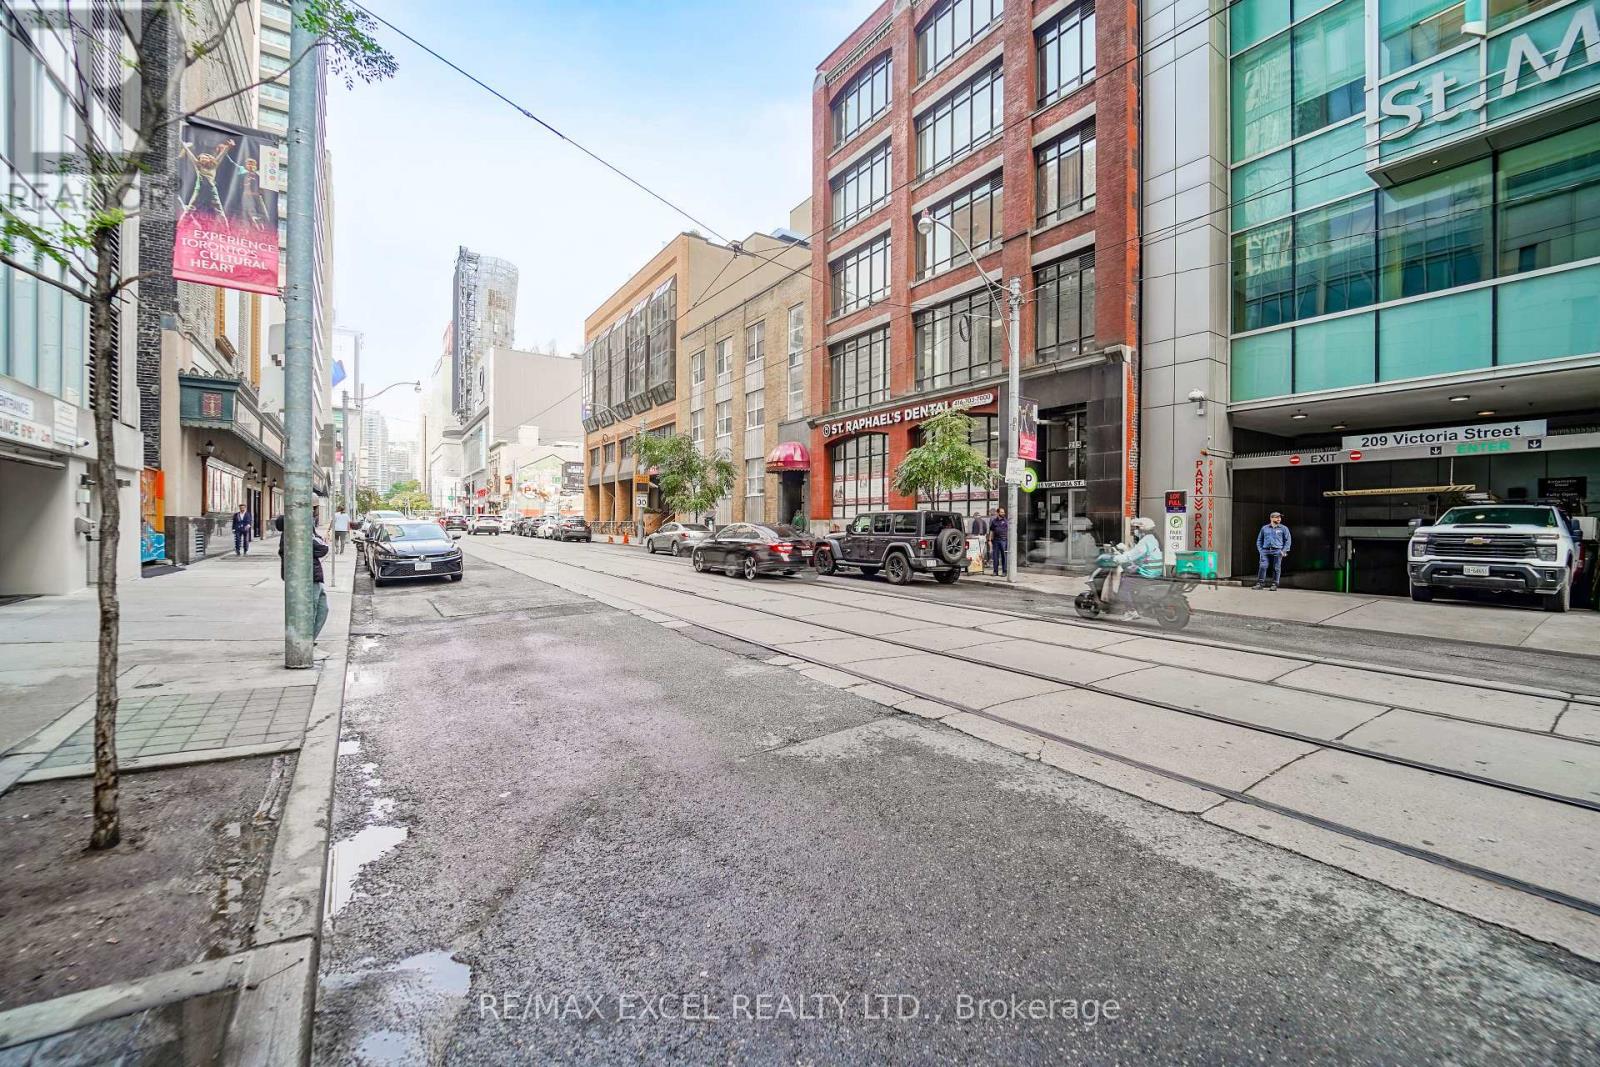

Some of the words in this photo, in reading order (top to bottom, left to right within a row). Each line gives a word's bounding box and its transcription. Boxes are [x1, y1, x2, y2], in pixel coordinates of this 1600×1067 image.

[1380, 71, 1485, 141] St.
[182, 237, 259, 259] TORONTO'S
[193, 229, 276, 253] EXPERIENCE
[189, 257, 236, 274] HEART
[200, 249, 269, 271] CULTURAL
[831, 423, 845, 435] ST.
[845, 409, 901, 433] RAPHAEL'S
[1361, 435, 1387, 448] 209
[1393, 430, 1459, 446] Victoria
[1464, 424, 1521, 440] Street
[1310, 453, 1337, 464] EXIT
[1456, 441, 1511, 455] ENTER
[1025, 474, 1033, 486] P
[1194, 460, 1204, 496] PARK
[637, 498, 647, 506] 30
[1194, 512, 1203, 548] PARK
